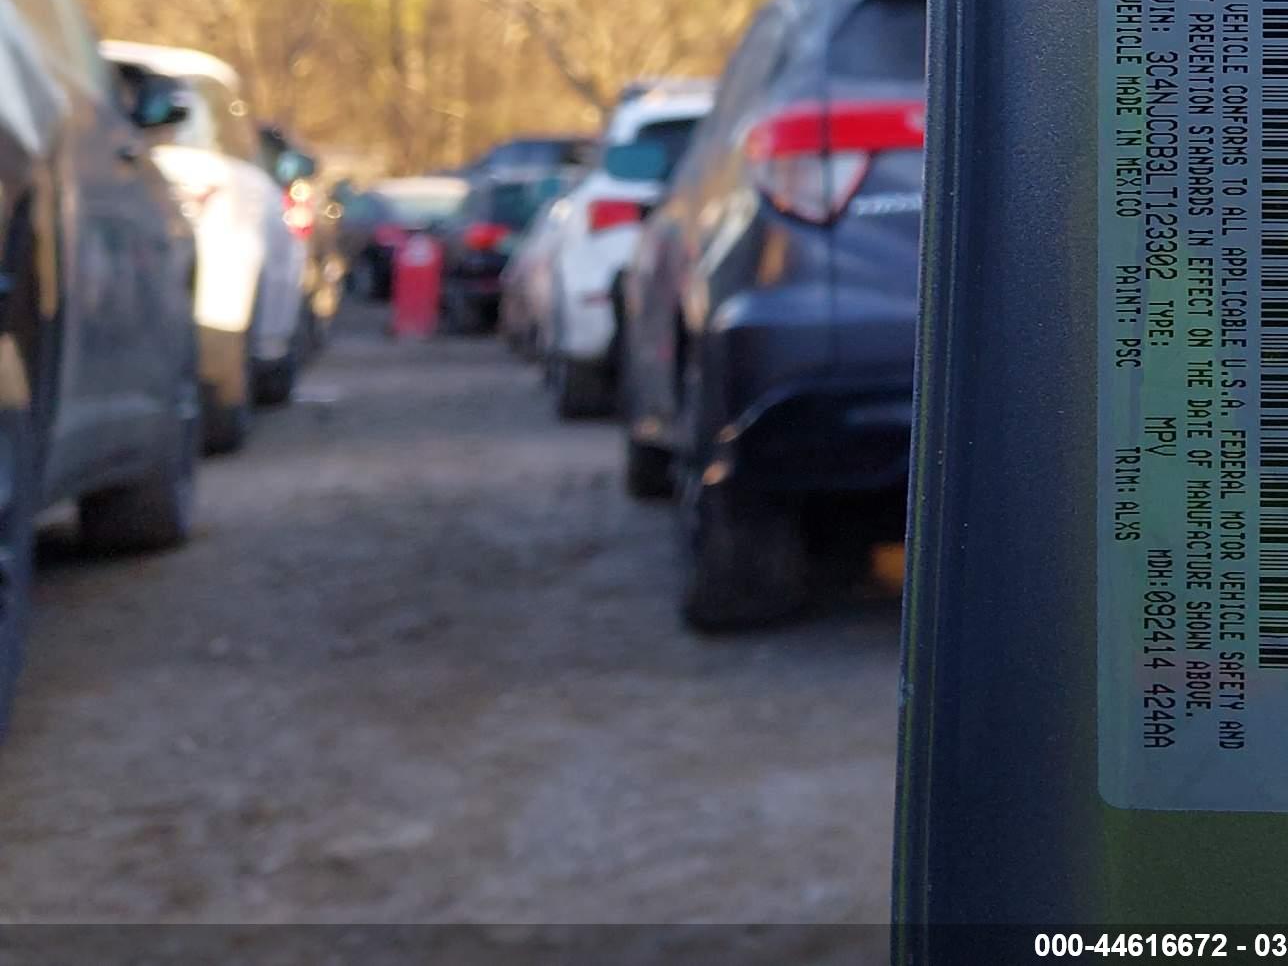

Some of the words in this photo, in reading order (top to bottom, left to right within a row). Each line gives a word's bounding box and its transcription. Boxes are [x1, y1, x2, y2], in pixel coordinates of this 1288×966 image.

[1223, 4, 1248, 73] VEHICLE
[1188, 14, 1214, 114] PREVENTION
[1117, 77, 1141, 115] MADE
[1116, 130, 1142, 146] IN
[1222, 86, 1248, 165] CONFORMS
[1116, 158, 1142, 216] MEXICO
[1145, 51, 1178, 279] 3C4NJCCB3LT123302
[1188, 126, 1214, 215] STANDARDS
[1222, 178, 1247, 195] TO
[1188, 230, 1214, 246] IN
[1222, 207, 1247, 236] ALL
[1116, 266, 1142, 322] PAINT:
[1188, 258, 1213, 316] EFFECT
[1221, 248, 1247, 347] APPLICABLE
[1149, 301, 1174, 345] TYPE:
[1188, 329, 1213, 347] ON
[1116, 339, 1141, 367] PSC
[1188, 360, 1213, 387] THE
[1221, 359, 1247, 416] U.S.A.
[1145, 418, 1176, 456] MPV
[1187, 400, 1212, 438] DATE
[1115, 447, 1141, 492] TRIM:
[1187, 450, 1212, 468] OF
[1220, 430, 1246, 499] FEDERAL
[1115, 502, 1140, 540] ALXS
[1186, 481, 1212, 590] MANUFACTURE
[1220, 511, 1246, 560] MOTOR
[1186, 602, 1211, 650] SHOWN
[1219, 572, 1245, 640] VEHICLE
[1186, 661, 1211, 716] ABOVE.
[1219, 652, 1245, 710] SAFETY
[1144, 684, 1176, 747] 424AA
[1219, 721, 1244, 749] AND
